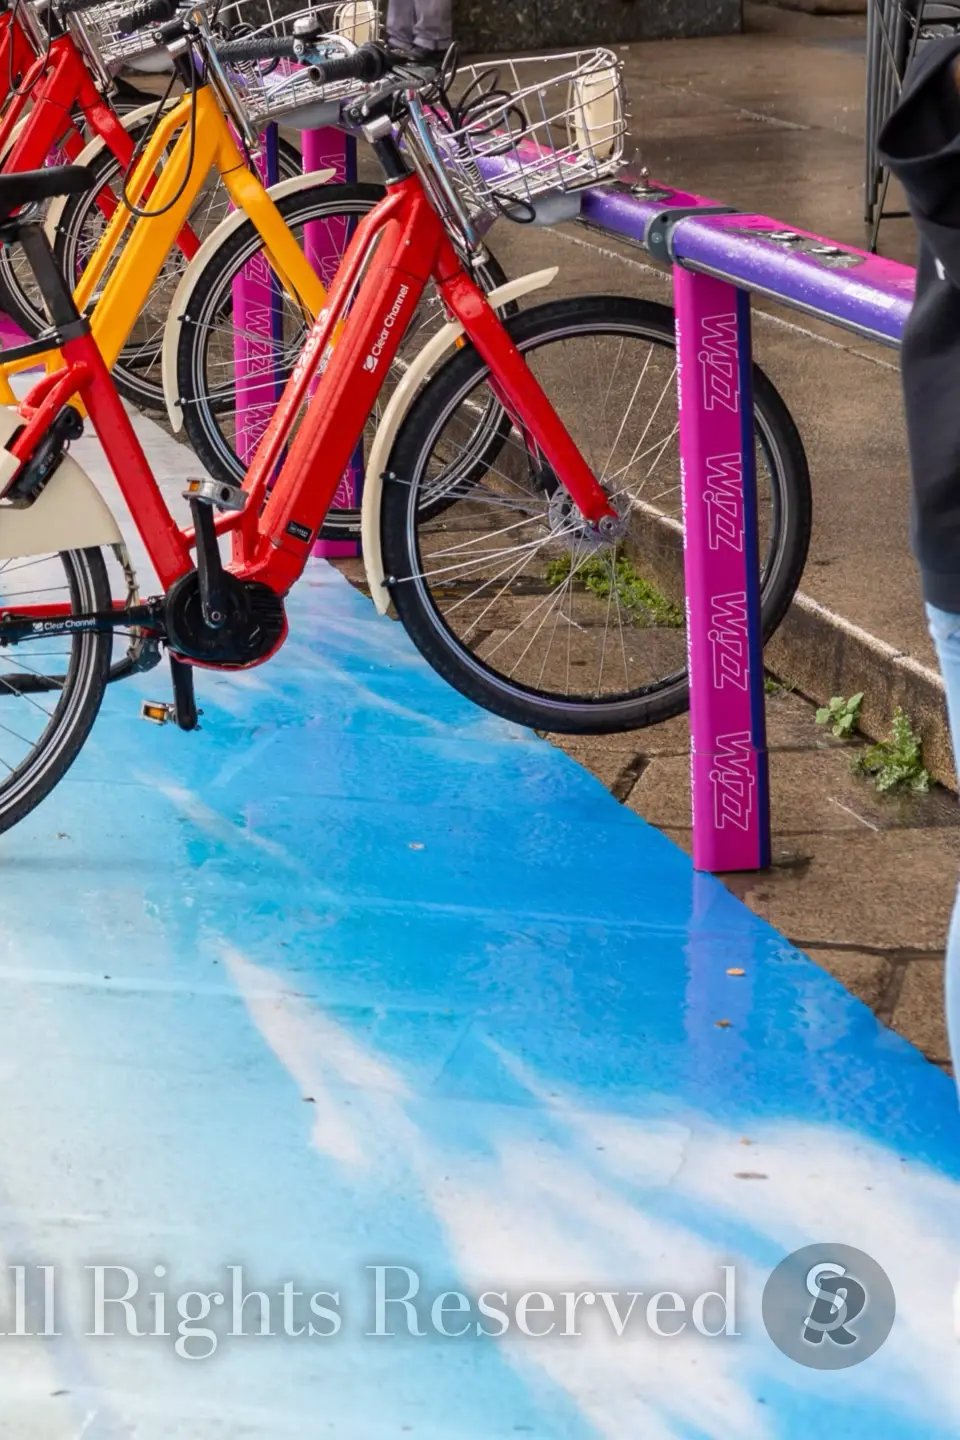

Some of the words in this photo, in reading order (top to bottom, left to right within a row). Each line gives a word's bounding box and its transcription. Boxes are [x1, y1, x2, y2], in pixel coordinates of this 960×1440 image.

[371, 327, 389, 357] Clear
[380, 284, 409, 329] Channel
[44, 621, 65, 630] Clear
[65, 617, 96, 629] Channel
